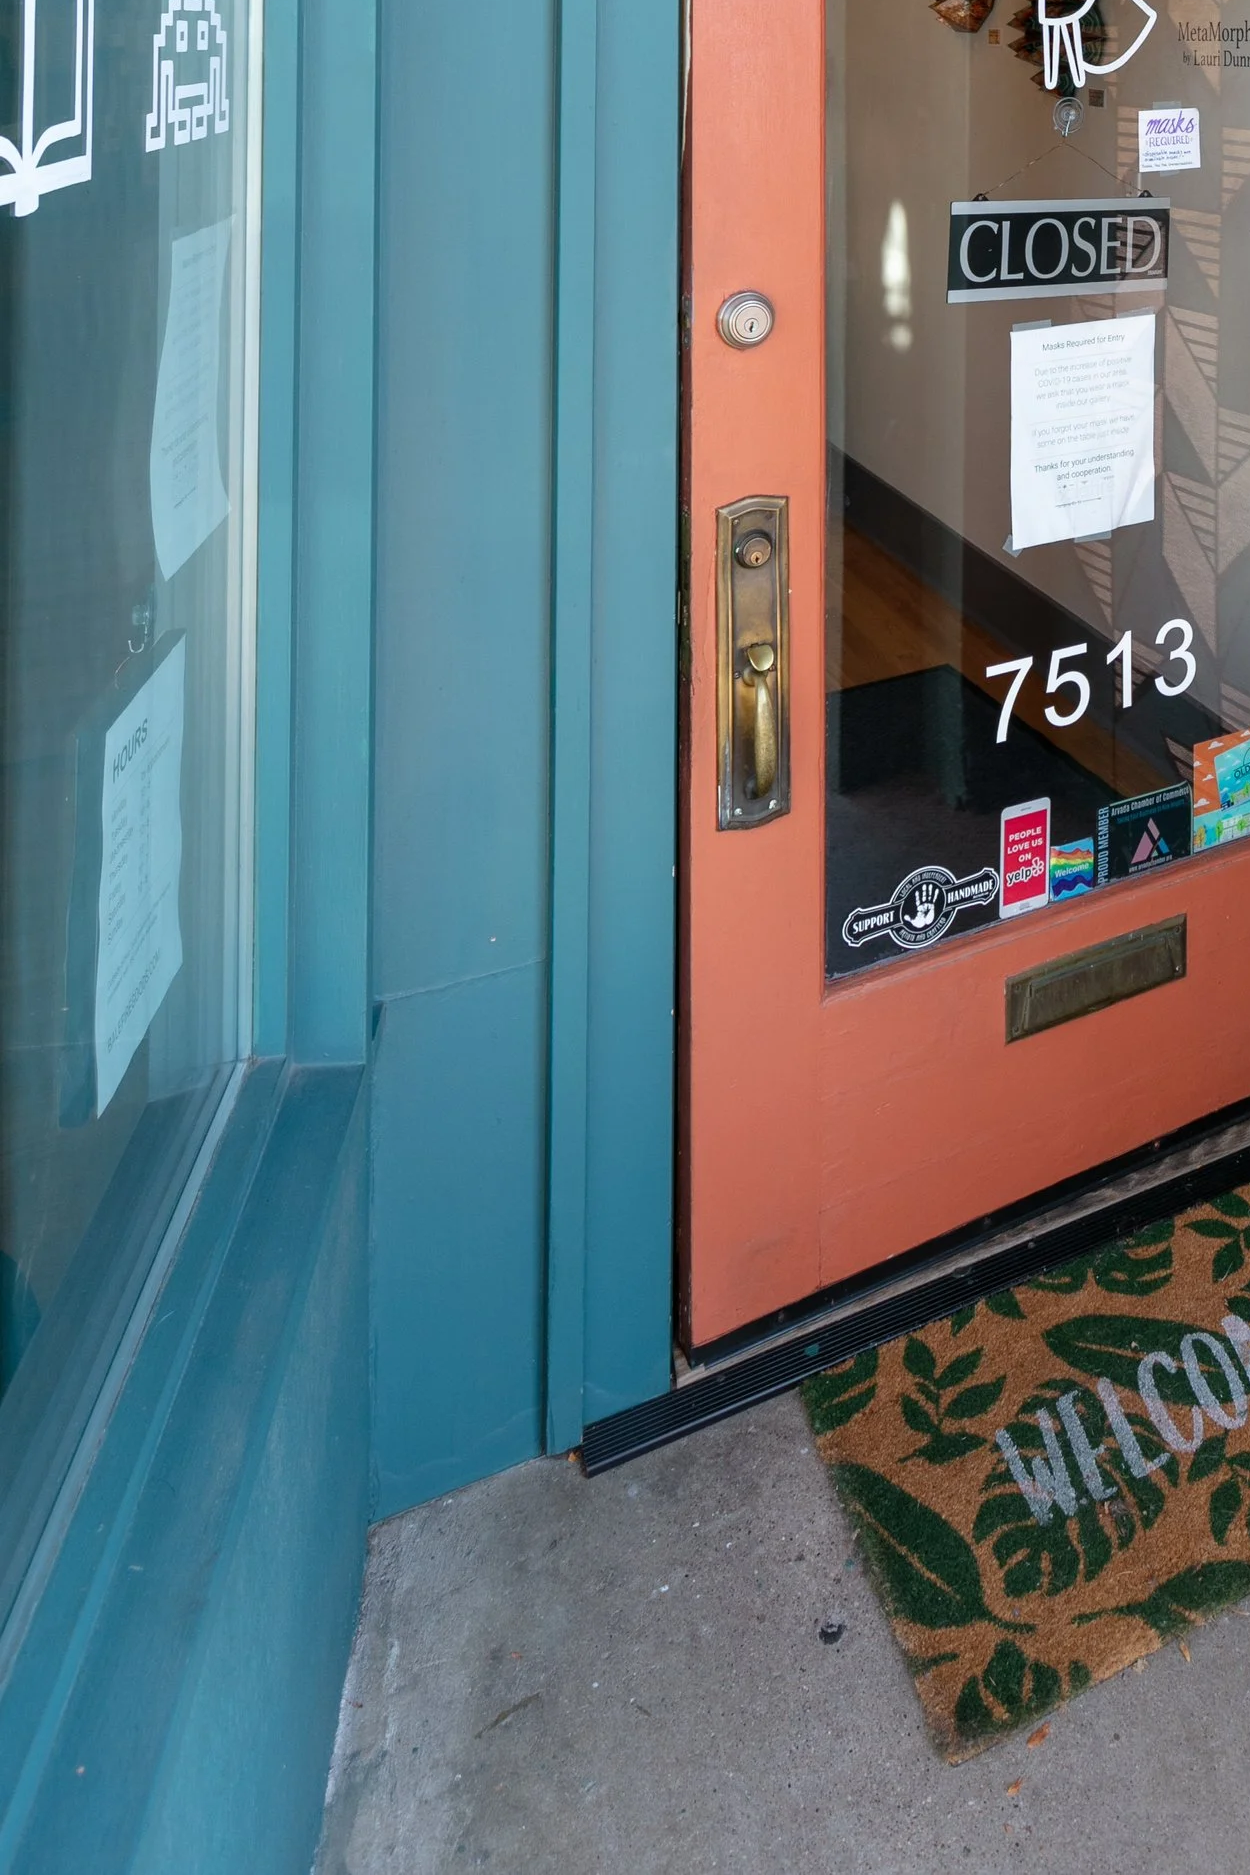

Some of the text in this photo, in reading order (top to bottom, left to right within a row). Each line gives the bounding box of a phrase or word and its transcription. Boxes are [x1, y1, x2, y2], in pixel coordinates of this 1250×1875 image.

[1182, 51, 1191, 66] by
[1193, 50, 1220, 66] Lauri
[1145, 110, 1195, 136] masks
[1149, 135, 1190, 147] REQUIRED
[960, 216, 1162, 282] CLOSED
[1042, 333, 1125, 351] Masks Required for Entry
[1034, 448, 1135, 473] Thanks for your understanding
[1056, 470, 1070, 481] and
[986, 618, 1197, 744] 7513
[112, 718, 148, 784] HOURS
[1111, 804, 1130, 817] Arvada
[1130, 796, 1155, 811] Chamber
[1156, 793, 1162, 803] of
[1162, 786, 1189, 801] Commerce
[1009, 826, 1043, 842] PEOPLE
[1007, 837, 1043, 854] LOVE US
[1097, 806, 1110, 884] PROUD MEMBER
[1018, 852, 1032, 863] ON
[1007, 867, 1033, 886] yelp
[1054, 862, 1089, 878] Welcome
[947, 879, 993, 904] HANDMADE
[852, 910, 895, 934] SUPPORT
